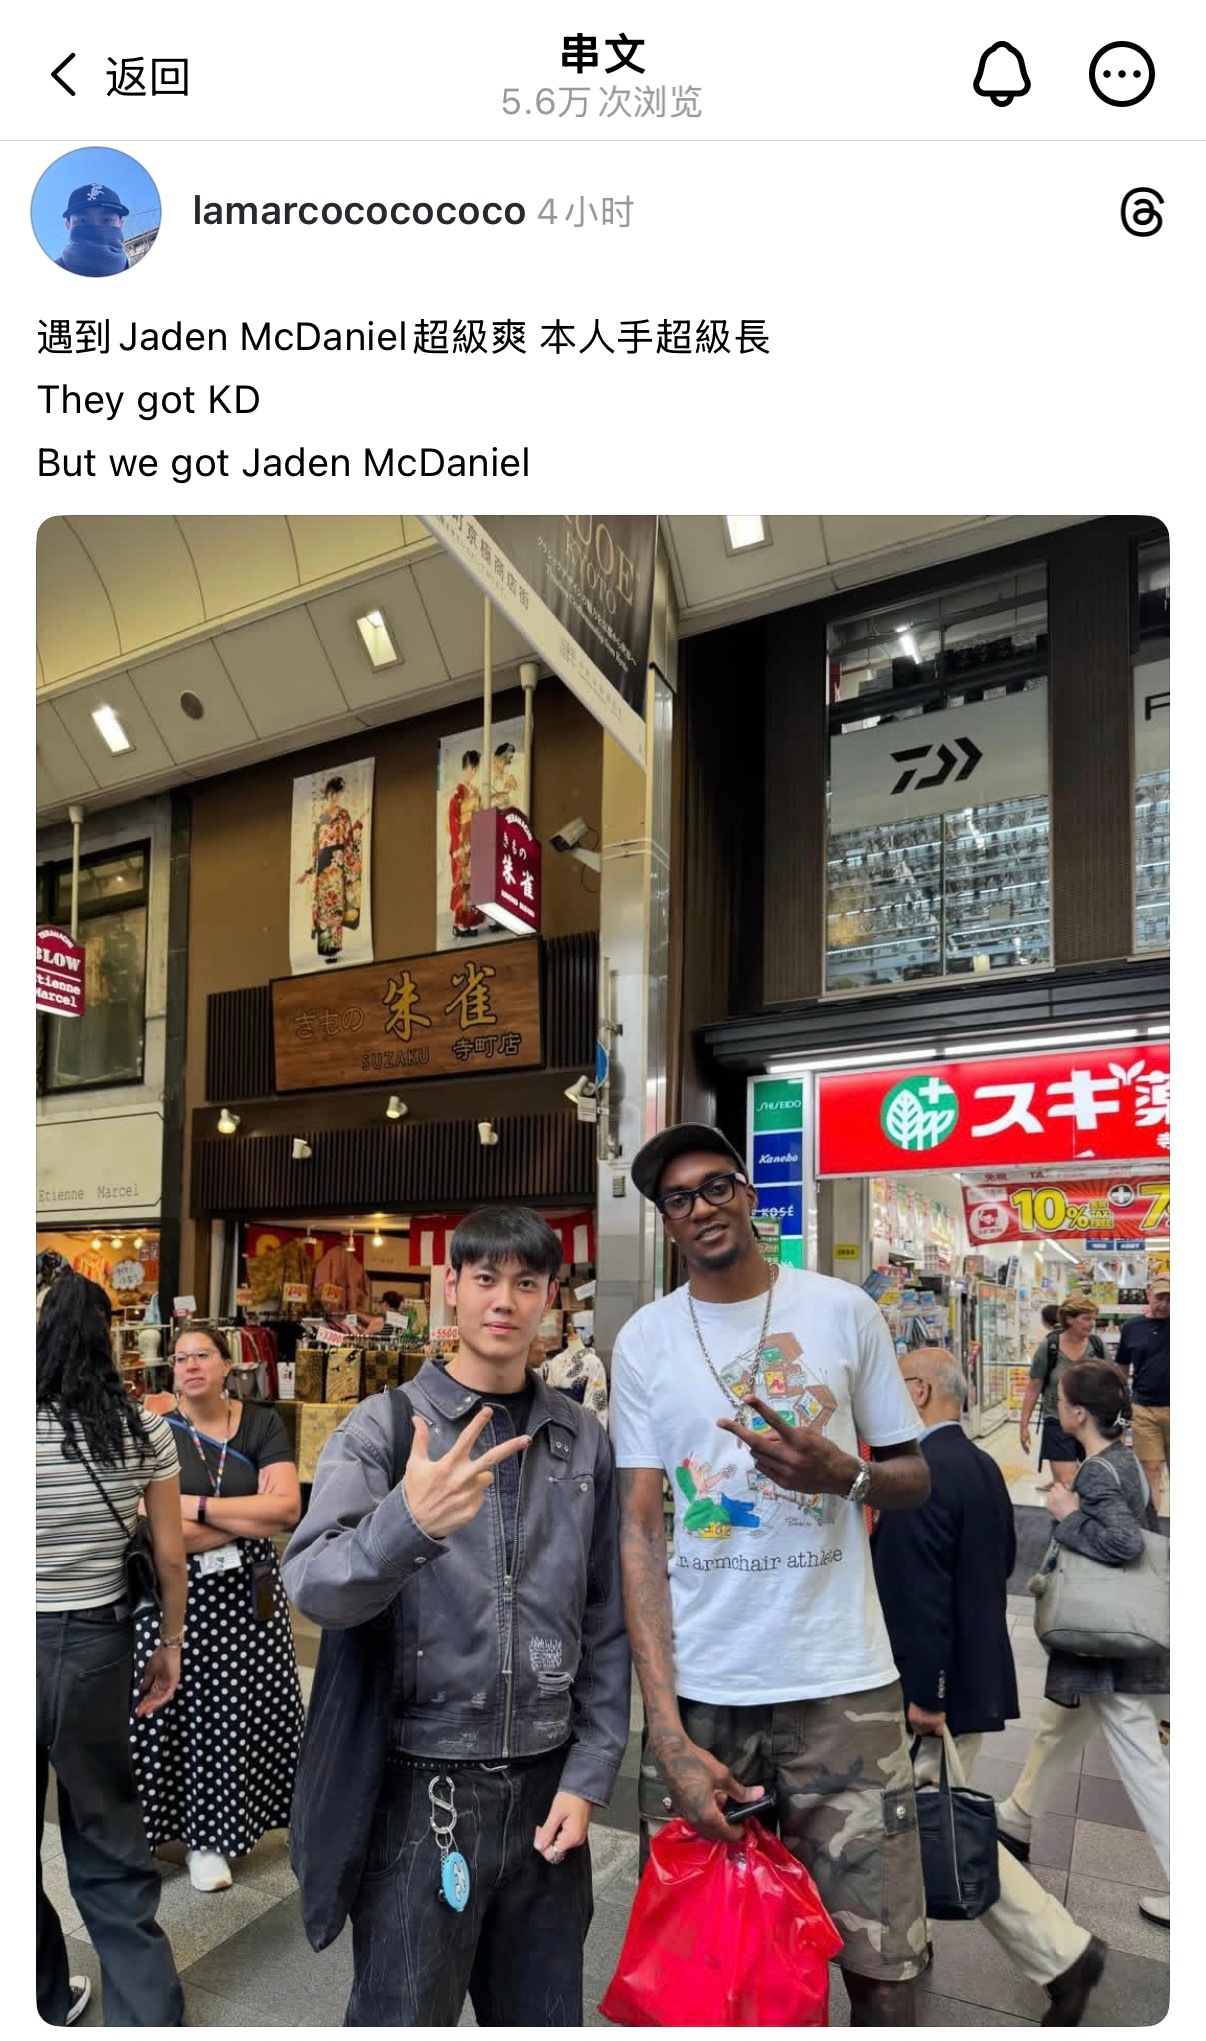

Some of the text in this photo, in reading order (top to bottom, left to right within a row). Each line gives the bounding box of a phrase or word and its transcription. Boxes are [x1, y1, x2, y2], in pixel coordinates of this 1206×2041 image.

[566, 526, 616, 615] KYOTO
[36, 973, 81, 995] tienne
[294, 961, 498, 1042] きもの 朱雀
[453, 1032, 523, 1062] 寺町店
[361, 1047, 430, 1072] SUZAKU
[757, 1099, 802, 1112] SHISEIDO
[758, 1153, 799, 1165] Kanebo
[38, 1184, 139, 1203] Etienne Marcel
[1011, 1187, 1090, 1232] 10%
[692, 1554, 782, 1572] armchair
